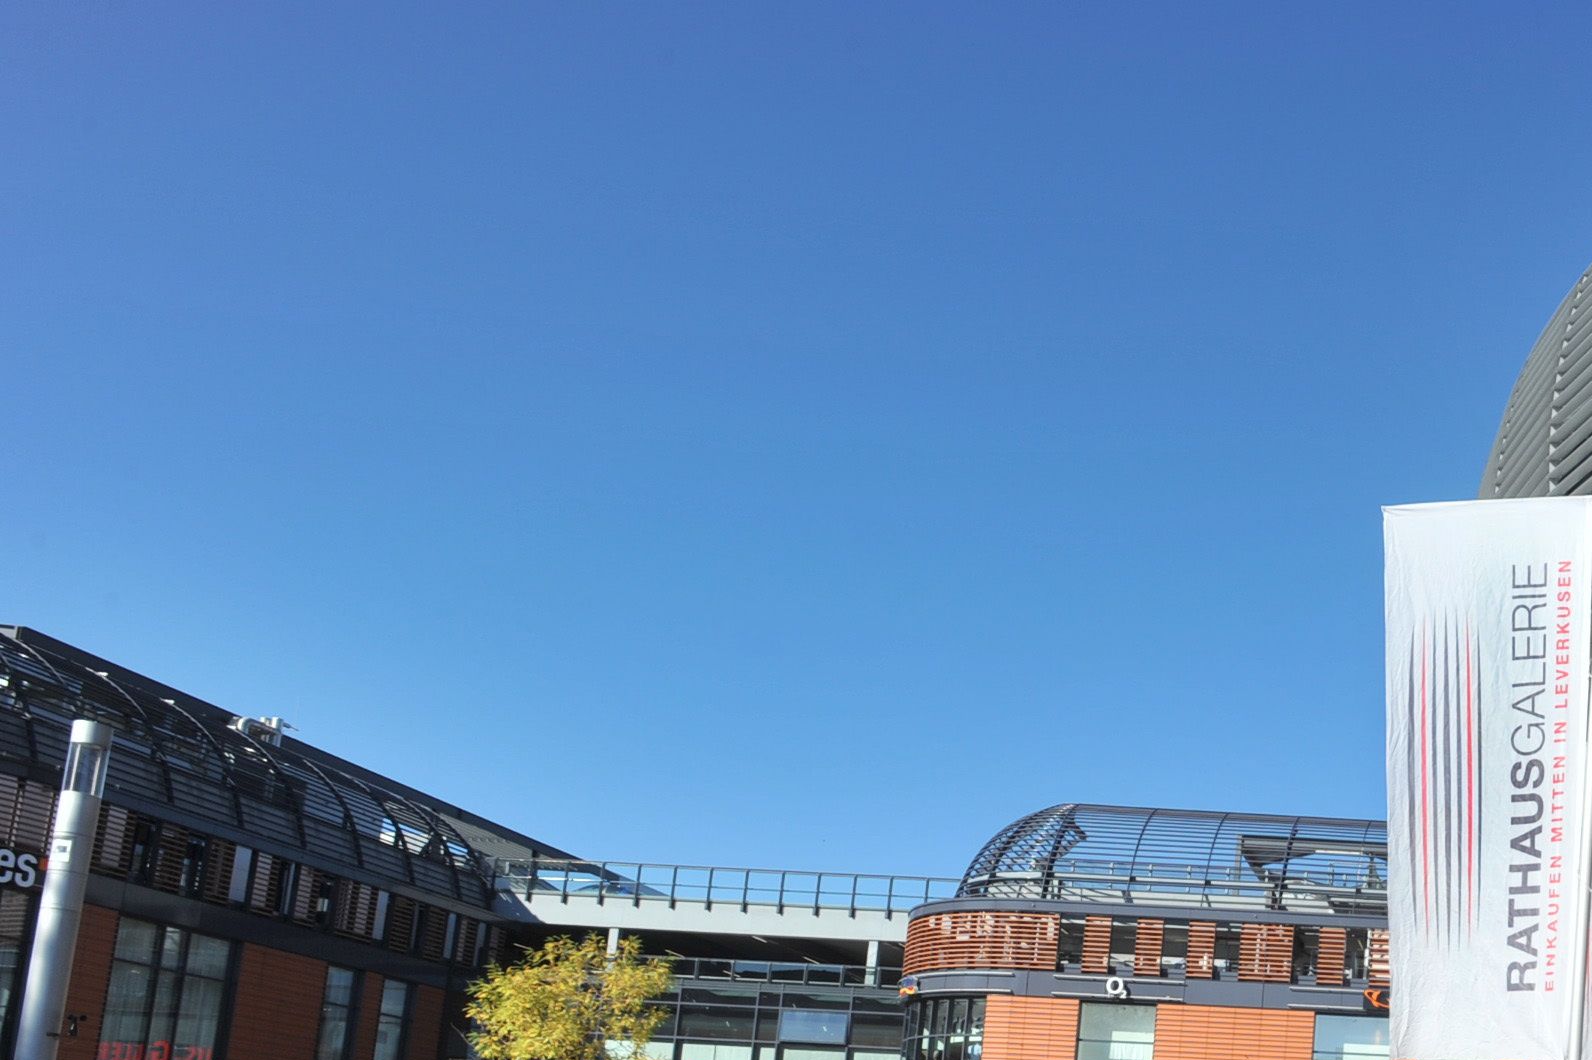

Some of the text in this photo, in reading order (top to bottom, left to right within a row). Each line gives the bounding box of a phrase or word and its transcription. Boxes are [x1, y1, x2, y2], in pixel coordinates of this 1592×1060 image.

[1506, 563, 1548, 992] RATHAUSGALERIE
[1545, 560, 1572, 992] EINKAUFEN MITTEN IN LEVERKUSEN
